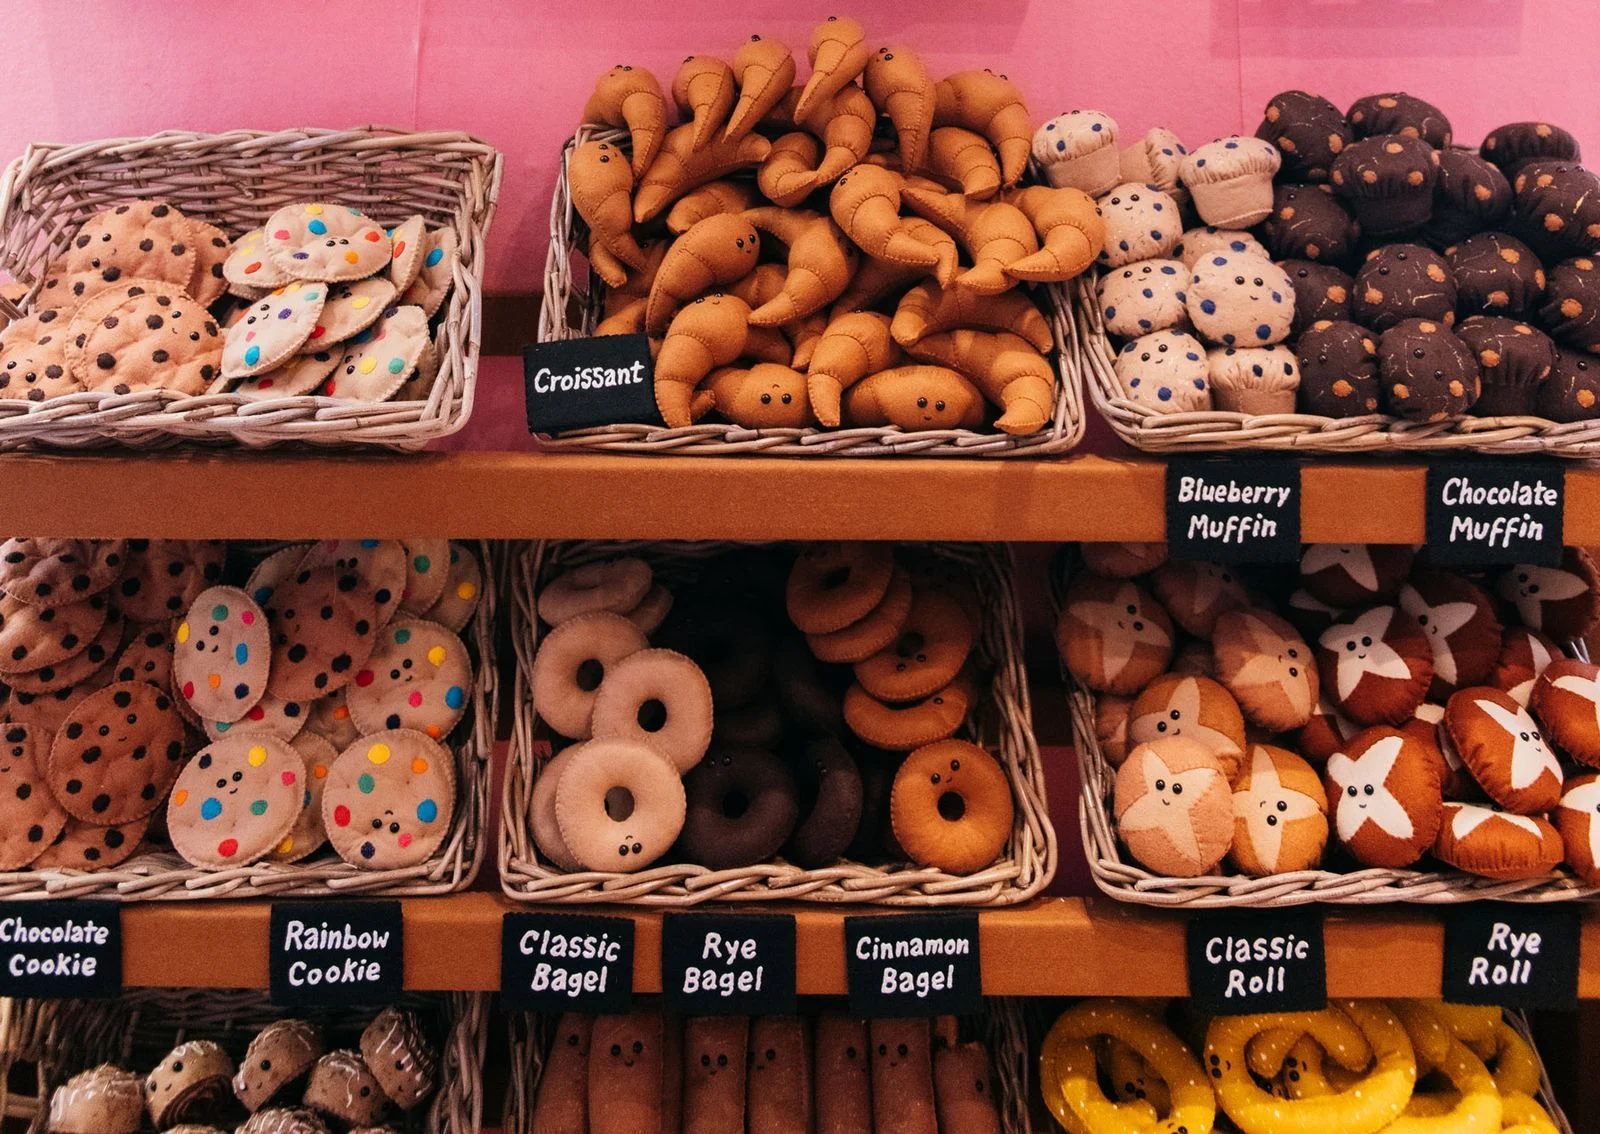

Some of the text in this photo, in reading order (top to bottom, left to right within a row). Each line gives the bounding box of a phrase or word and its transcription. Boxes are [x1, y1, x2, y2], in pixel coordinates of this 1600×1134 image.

[533, 360, 645, 394] Croissant
[1178, 476, 1291, 508] Blueberry
[1442, 477, 1558, 507] Chocolate
[1187, 512, 1277, 544] Muffin
[1449, 513, 1544, 549] Muffin
[0, 916, 109, 945] Chocolate
[284, 920, 390, 951] Rainbow
[519, 929, 621, 962] Classic
[1487, 922, 1542, 958] Rye
[8, 952, 97, 977] Cookie
[702, 931, 757, 966] Rye
[855, 936, 970, 961] Cinnamon
[1205, 934, 1309, 965] Classic
[288, 957, 381, 987] Cookie
[530, 962, 608, 998] Bagel
[682, 965, 764, 997] Bagel
[880, 964, 955, 998] Bagel
[1224, 966, 1285, 998] Roll
[1468, 956, 1532, 985] Roll
